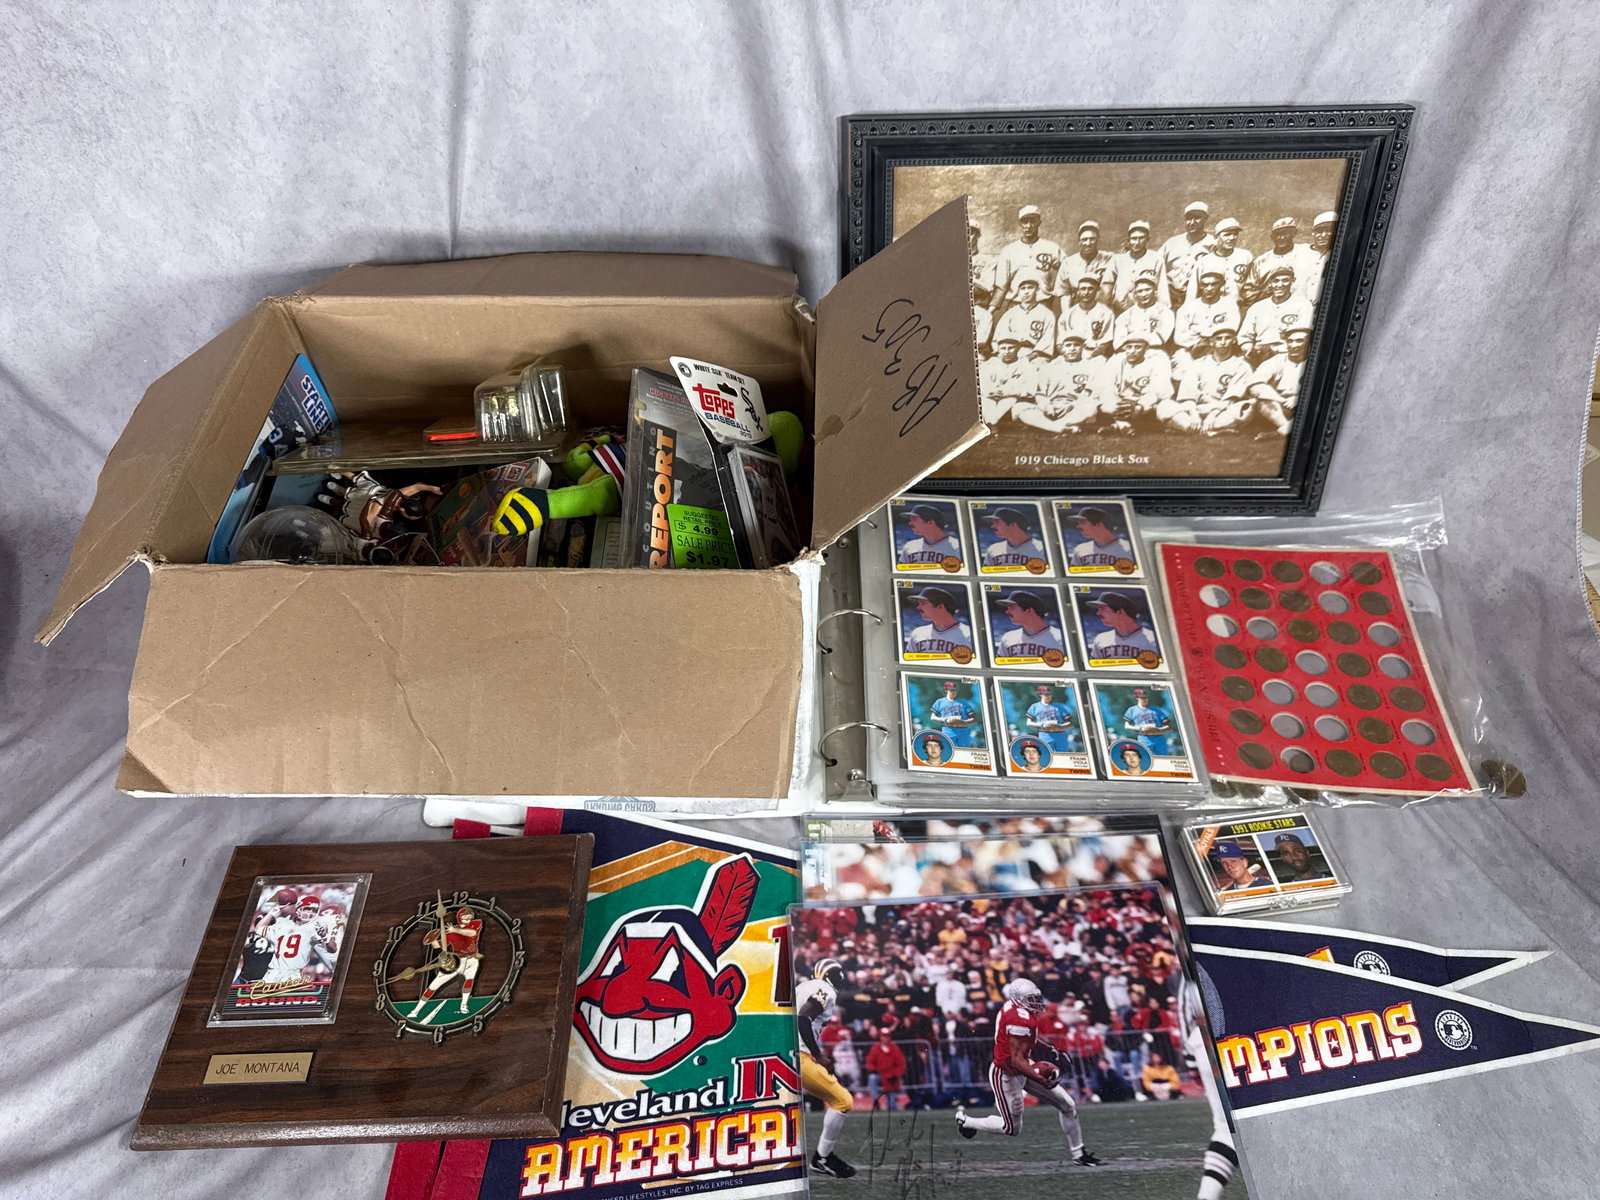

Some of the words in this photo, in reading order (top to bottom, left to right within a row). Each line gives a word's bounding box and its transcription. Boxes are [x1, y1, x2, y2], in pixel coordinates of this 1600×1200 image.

[704, 412, 751, 433] BASEBALL
[1014, 455, 1041, 465] 1919
[1044, 455, 1090, 467] Chicago
[1092, 454, 1124, 464] Black
[1128, 454, 1150, 464] Sox
[642, 426, 658, 568] COUTING
[650, 428, 677, 568] REPORT
[676, 534, 704, 550] SALE
[705, 539, 736, 554] PRICE
[686, 550, 729, 568] $1.97
[1230, 824, 1250, 834] 1991
[1247, 822, 1274, 832] ROOKIE
[1272, 818, 1296, 829] STARS
[453, 891, 468, 906] 12
[488, 896, 496, 912] 1
[418, 902, 431, 916] 11
[388, 926, 404, 942] 10
[512, 918, 522, 934] 2
[275, 934, 302, 959] 19
[514, 951, 526, 967] 3
[374, 960, 383, 976] 9
[250, 974, 312, 1000] Canton
[502, 985, 511, 1002] 4
[236, 996, 318, 1008] BOUND
[376, 994, 385, 1011] 8
[396, 1020, 406, 1038] 7
[473, 1015, 484, 1032] 5
[434, 1026, 444, 1044] 6
[216, 1064, 238, 1074] JOE
[244, 1062, 300, 1074] MONTANA
[696, 1184, 710, 1192] TAG
[711, 1178, 744, 1189] EXPRESS
